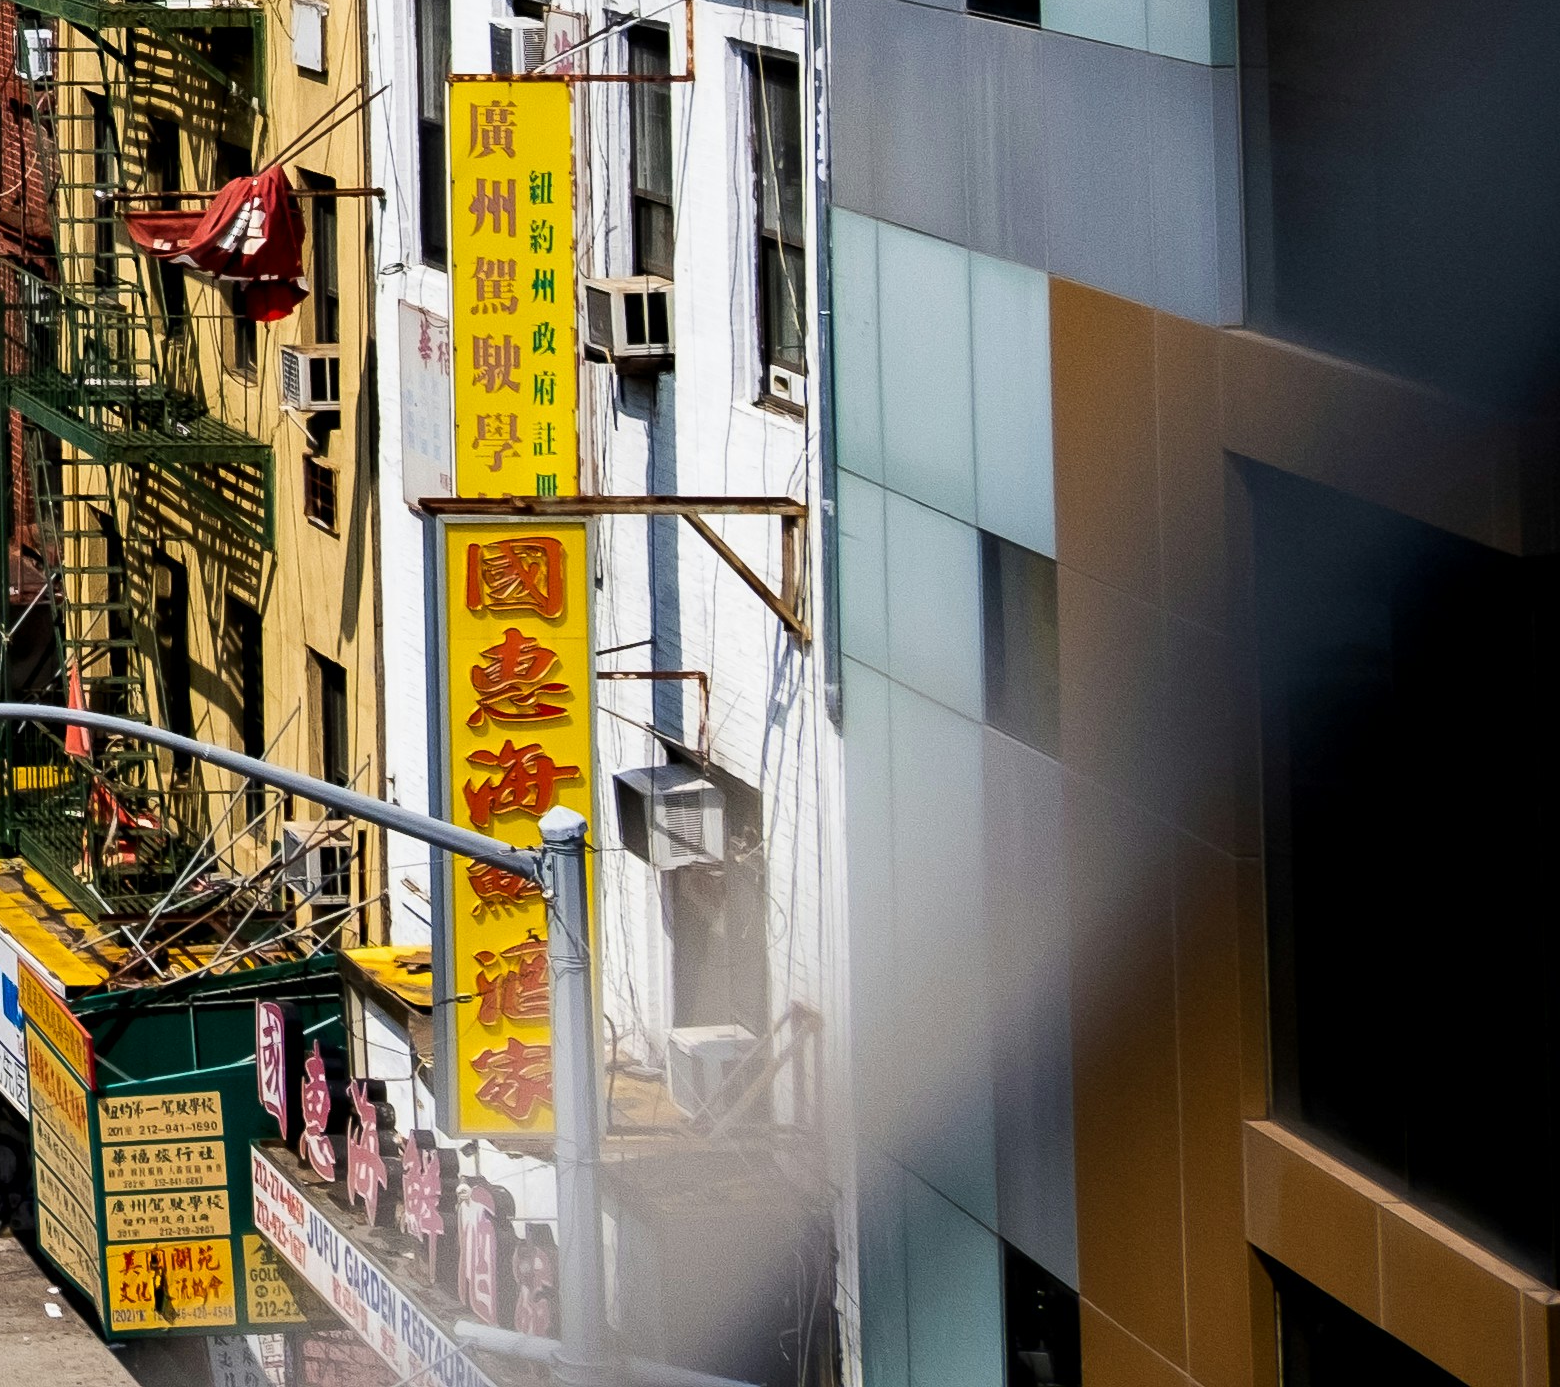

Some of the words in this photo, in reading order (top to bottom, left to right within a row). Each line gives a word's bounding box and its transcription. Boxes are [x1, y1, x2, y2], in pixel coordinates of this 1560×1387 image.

[467, 100, 524, 498] 廣州駕駛學
[306, 1210, 340, 1269] JUFU
[344, 1245, 397, 1327] GARDEN
